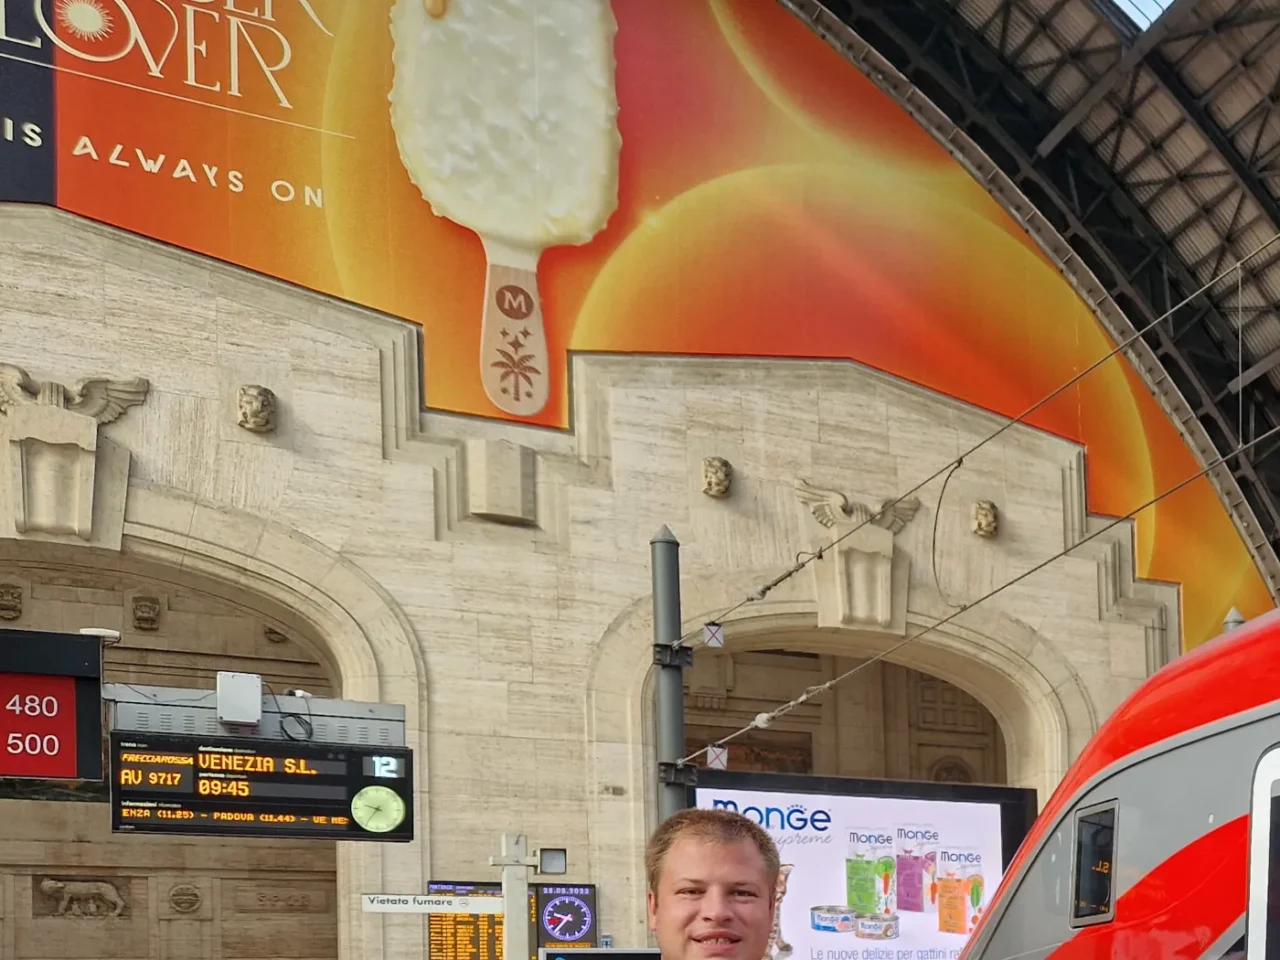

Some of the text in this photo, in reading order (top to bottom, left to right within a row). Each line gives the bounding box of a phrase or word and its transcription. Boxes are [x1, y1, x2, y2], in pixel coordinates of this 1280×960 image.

[3, 117, 323, 209] IS ALWAYS ON
[502, 290, 528, 314] M
[5, 694, 59, 717] 480
[6, 732, 60, 756] 500
[121, 753, 194, 766] FRECCIAROSSA
[198, 753, 318, 775] VENEZIA S.L.
[372, 754, 398, 778] 12
[121, 769, 182, 786] AV 9717
[198, 779, 250, 797] 09:45
[121, 808, 151, 818] ENZA
[157, 809, 194, 819] (11.25)
[213, 811, 255, 821] PADOVA
[259, 814, 296, 823] (11.44)
[312, 815, 327, 824] VE
[773, 833, 832, 853] upreme
[367, 896, 453, 906] Vietato fumare
[810, 947, 824, 960] Le
[827, 950, 859, 960] nuove
[862, 947, 894, 960] delizie
